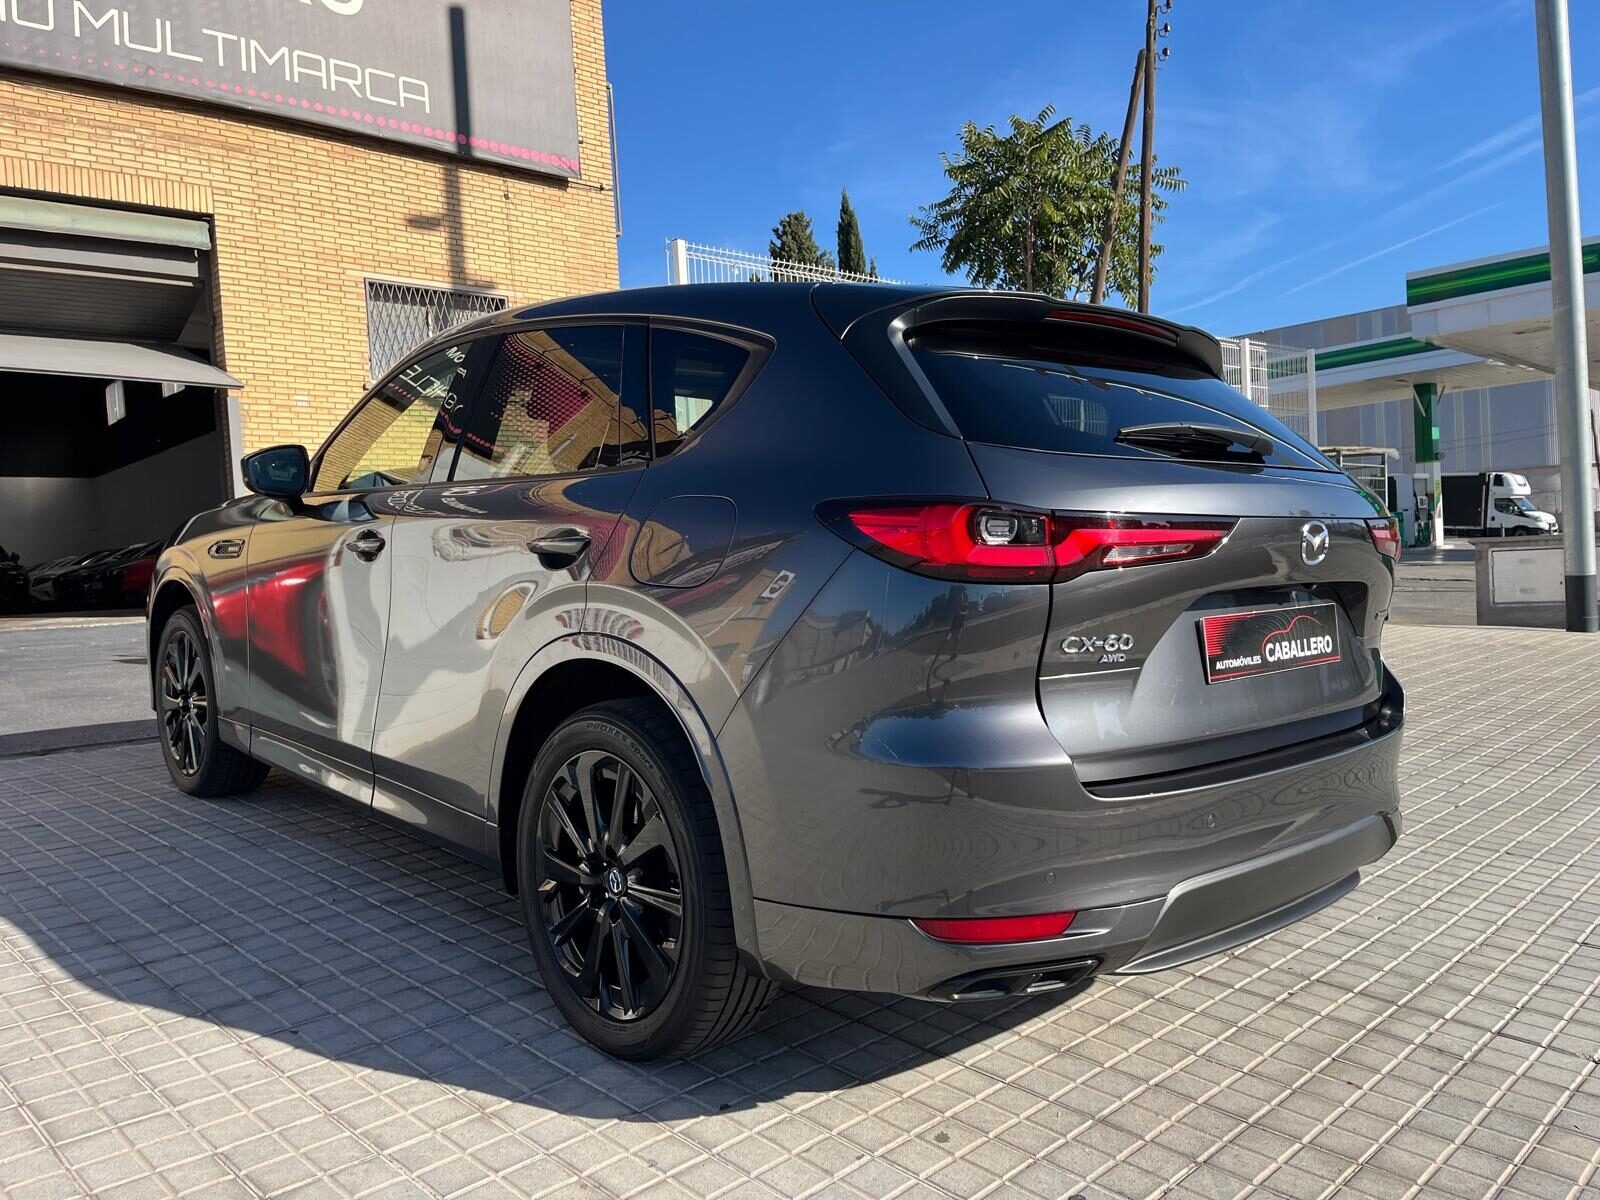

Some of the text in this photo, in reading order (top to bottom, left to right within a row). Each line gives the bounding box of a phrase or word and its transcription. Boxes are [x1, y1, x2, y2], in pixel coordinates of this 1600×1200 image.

[73, 0, 430, 113] MULTIMARCA
[1062, 634, 1134, 653] CX-60
[1215, 635, 1333, 670] AUTOMÓVILES CABALLERO
[1099, 653, 1126, 663] AWD
